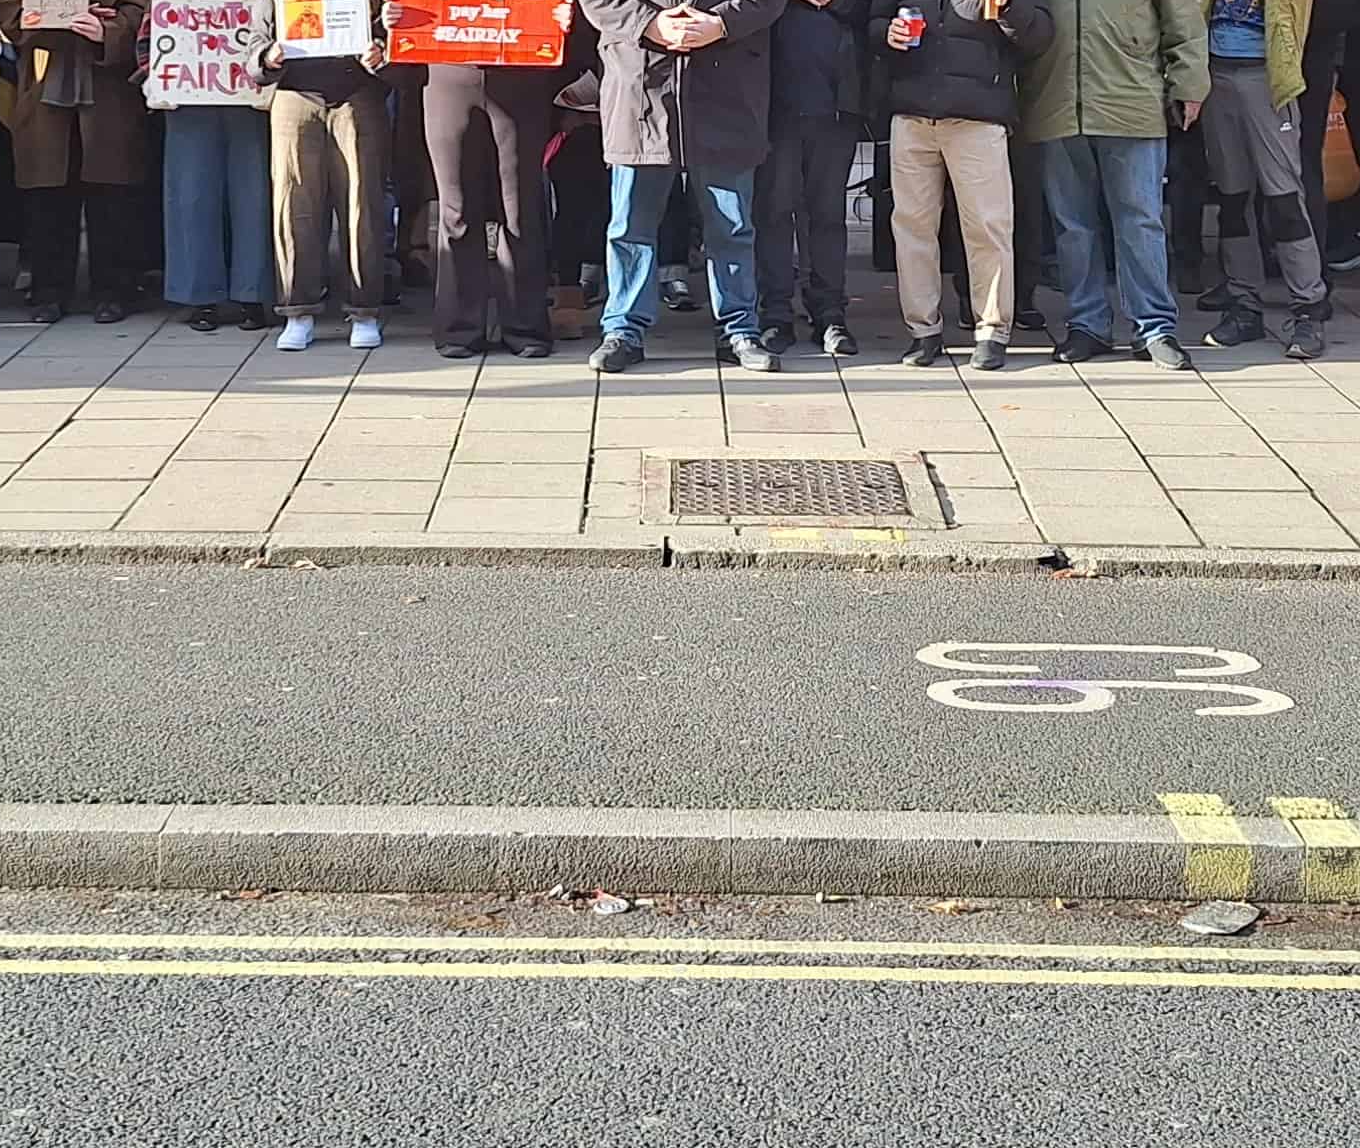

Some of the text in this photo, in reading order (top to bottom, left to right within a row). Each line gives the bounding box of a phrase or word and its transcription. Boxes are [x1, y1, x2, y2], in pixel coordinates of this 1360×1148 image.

[448, 3, 511, 22] pay her
[196, 32, 240, 55] FOR
[432, 25, 523, 44] #FAIRPAY
[158, 62, 238, 95] FAIR
